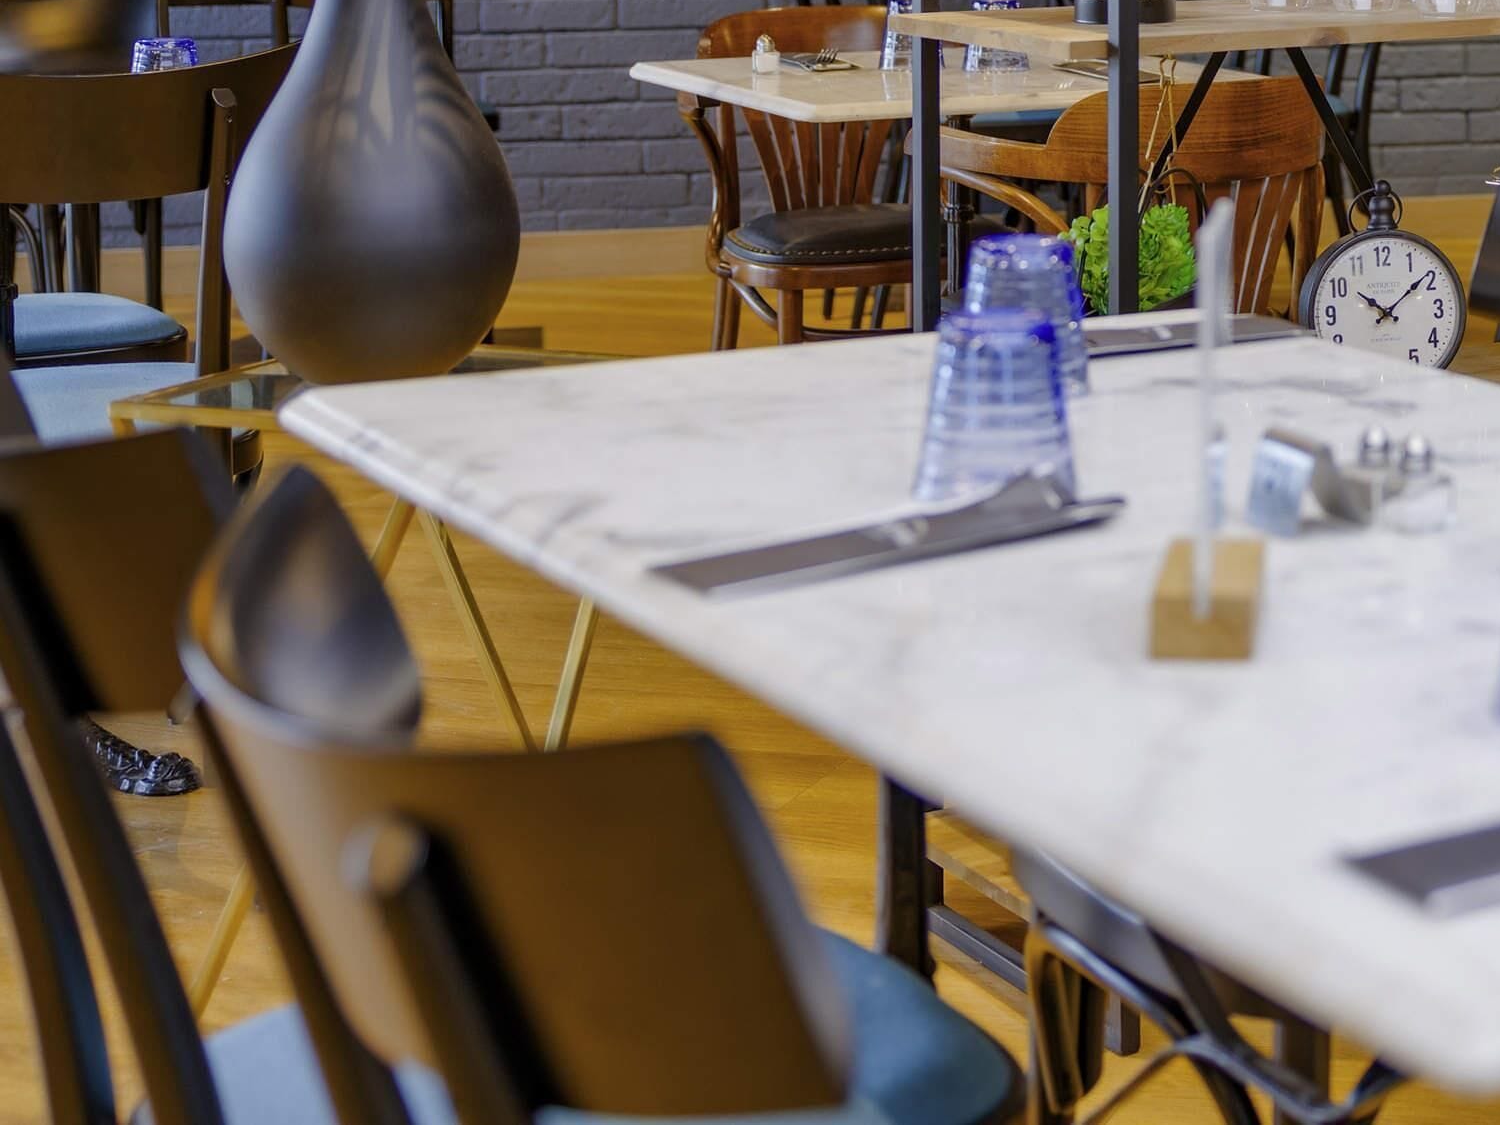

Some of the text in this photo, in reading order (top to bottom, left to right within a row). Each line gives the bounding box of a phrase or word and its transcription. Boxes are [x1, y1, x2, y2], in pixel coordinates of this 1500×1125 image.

[1350, 255, 1364, 276] 11
[1373, 246, 1391, 267] 12
[1406, 252, 1413, 273] 1
[1330, 277, 1348, 298] 10
[1426, 270, 1437, 291] 2
[1325, 305, 1337, 326] 9
[1433, 298, 1444, 319] 3
[1428, 327, 1439, 348] 4
[1408, 349, 1419, 363] 5
